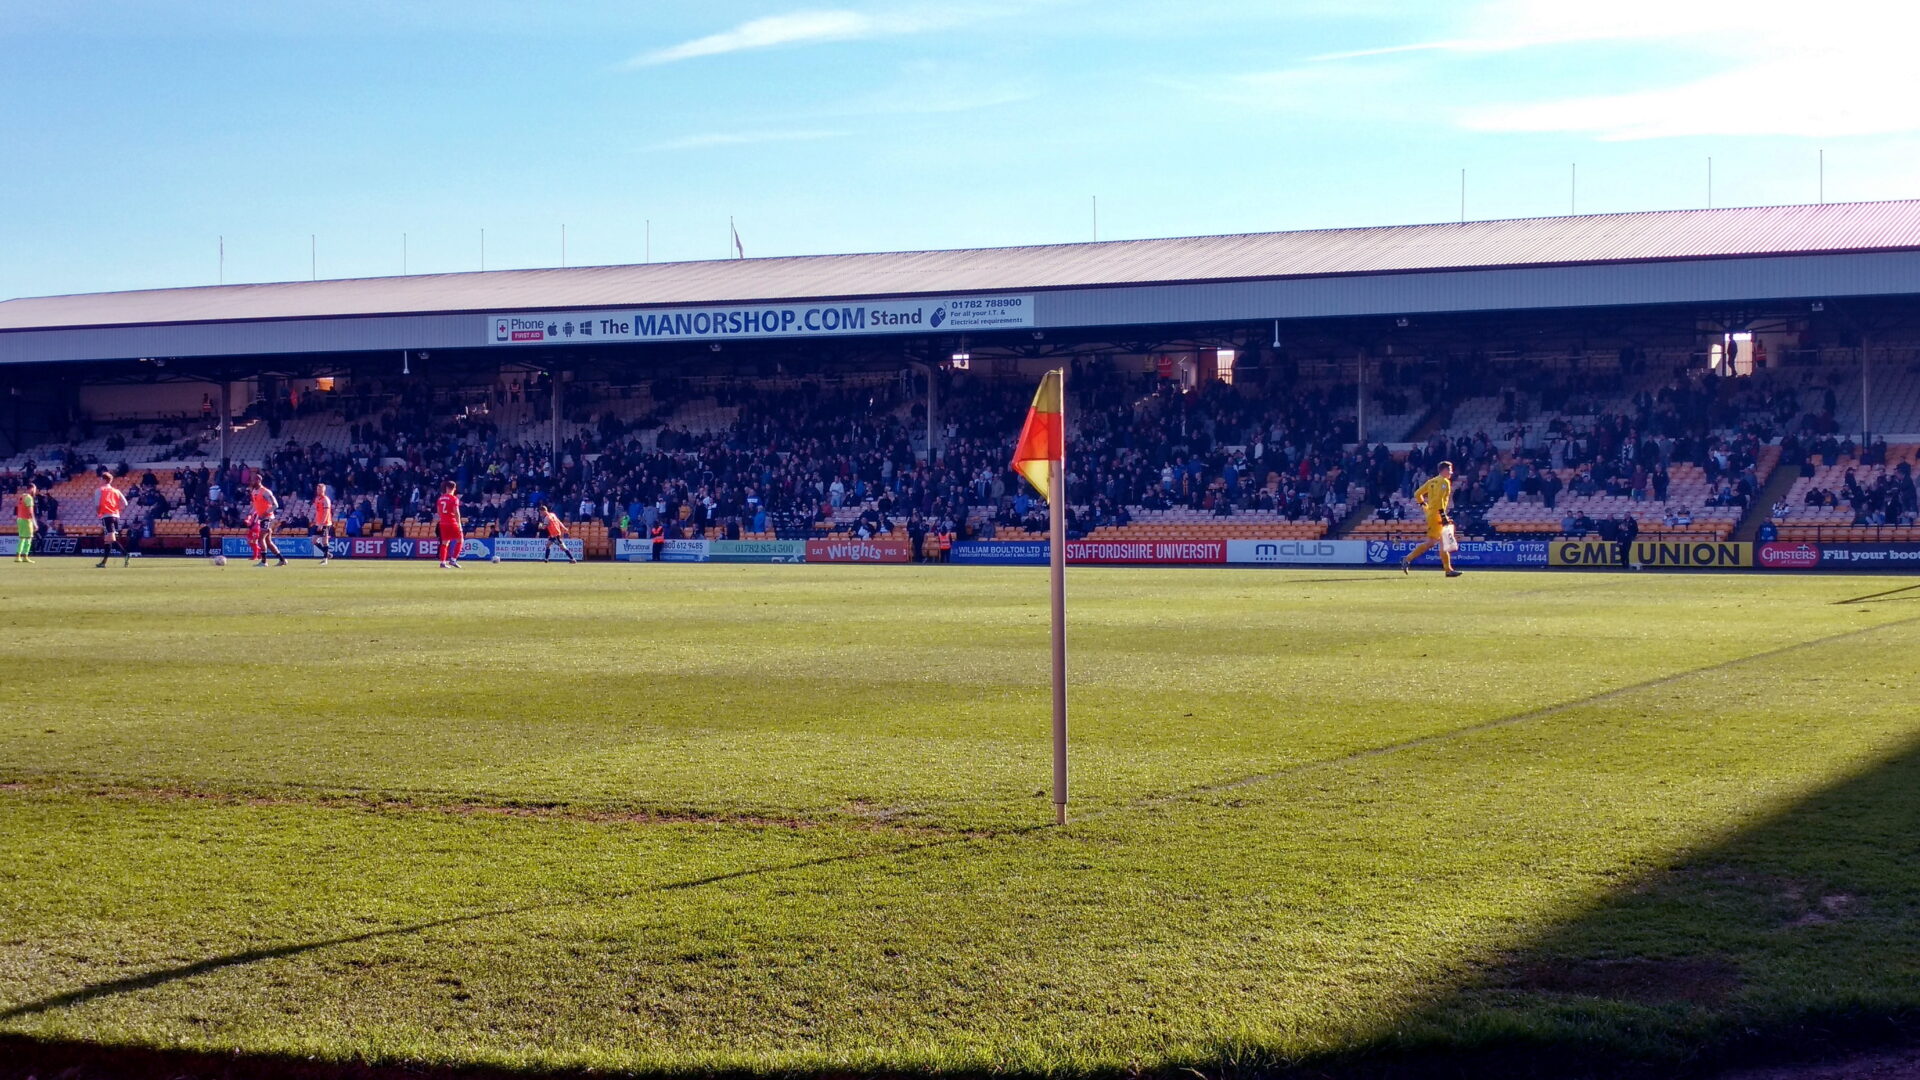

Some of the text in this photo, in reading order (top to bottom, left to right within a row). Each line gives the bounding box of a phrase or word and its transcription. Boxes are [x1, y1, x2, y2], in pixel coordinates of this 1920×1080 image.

[951, 298, 1022, 309] 01782 788900
[511, 318, 544, 330] Phone
[600, 306, 922, 337] The MANORSHOP.COM Stand
[950, 317, 1023, 326] Electrical requirements
[440, 501, 448, 513] 2
[355, 540, 384, 554] BET
[390, 538, 414, 556] sky
[676, 541, 687, 550] 612
[688, 541, 704, 550] 9485
[735, 544, 759, 553] 01782
[827, 541, 882, 560] Wrights
[1066, 543, 1154, 559] STAFFORDSHIRE
[1156, 543, 1221, 559] UNIVERSITY
[1392, 542, 1408, 551] GB
[1519, 543, 1545, 552] 01782
[1516, 554, 1547, 562] 814444
[1637, 542, 1741, 566] UNION
[1823, 549, 1850, 560] Fill
[1851, 550, 1888, 561] your
